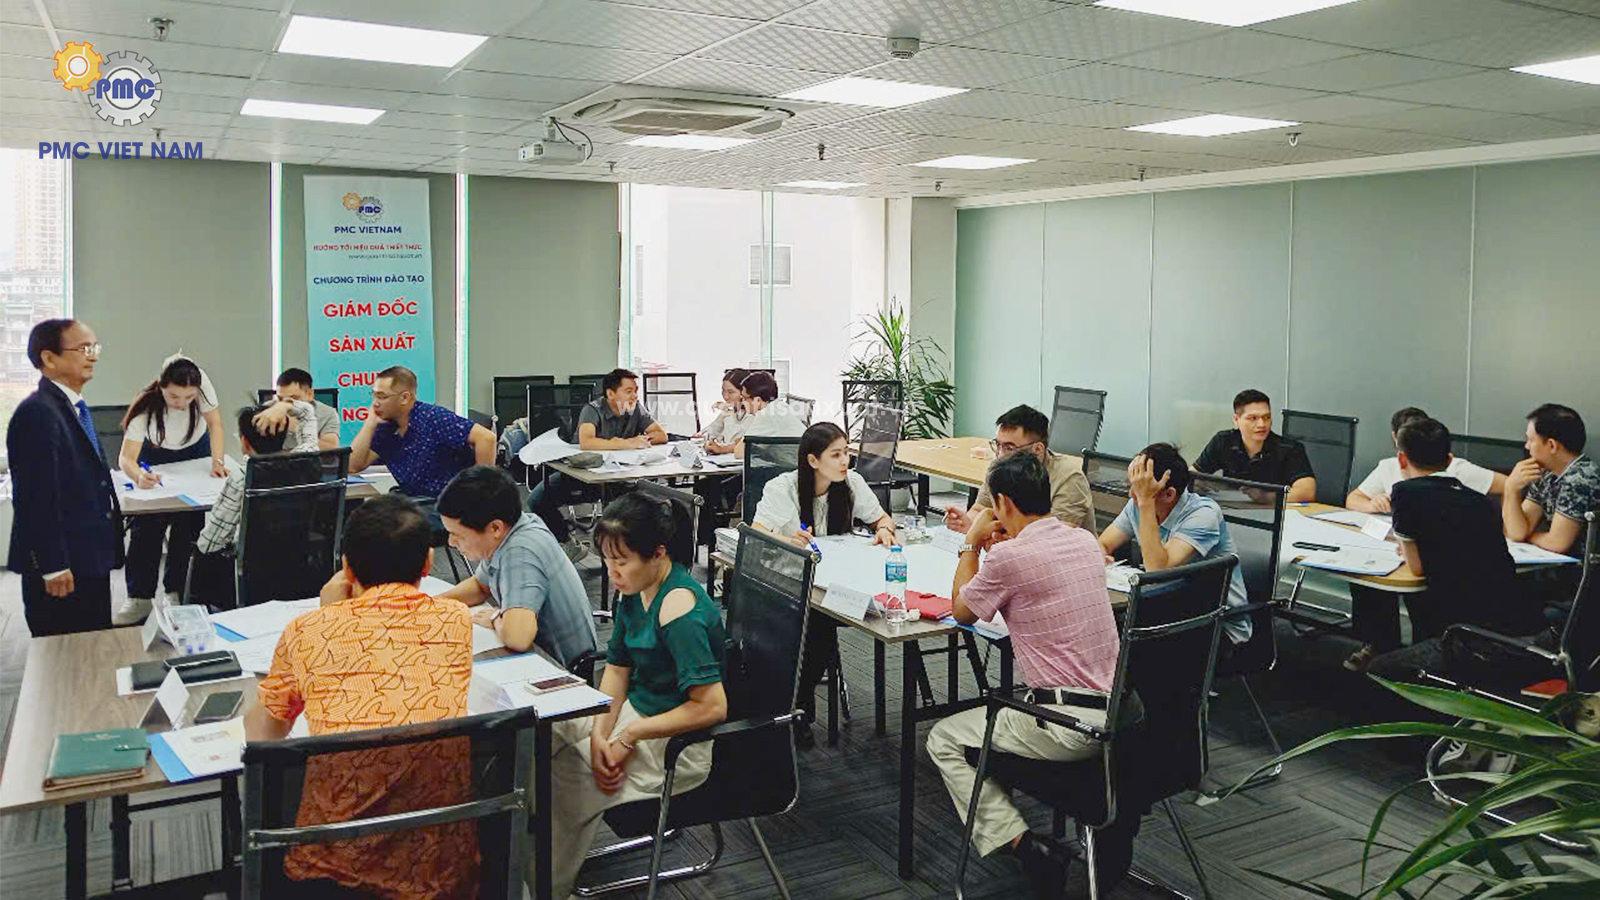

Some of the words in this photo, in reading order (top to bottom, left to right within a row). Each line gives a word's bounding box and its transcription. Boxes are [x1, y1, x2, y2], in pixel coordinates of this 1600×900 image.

[358, 205, 382, 213] PMC
[334, 226, 356, 234] PMC
[358, 226, 402, 234] VIETNAM
[356, 274, 382, 284] TRÌNH
[406, 275, 425, 284] TẠO
[323, 300, 372, 317] GIÁM
[377, 297, 418, 316] ĐỐC
[329, 334, 365, 353] SẢN
[371, 331, 415, 351] XUẤT
[338, 372, 381, 387] CHU
